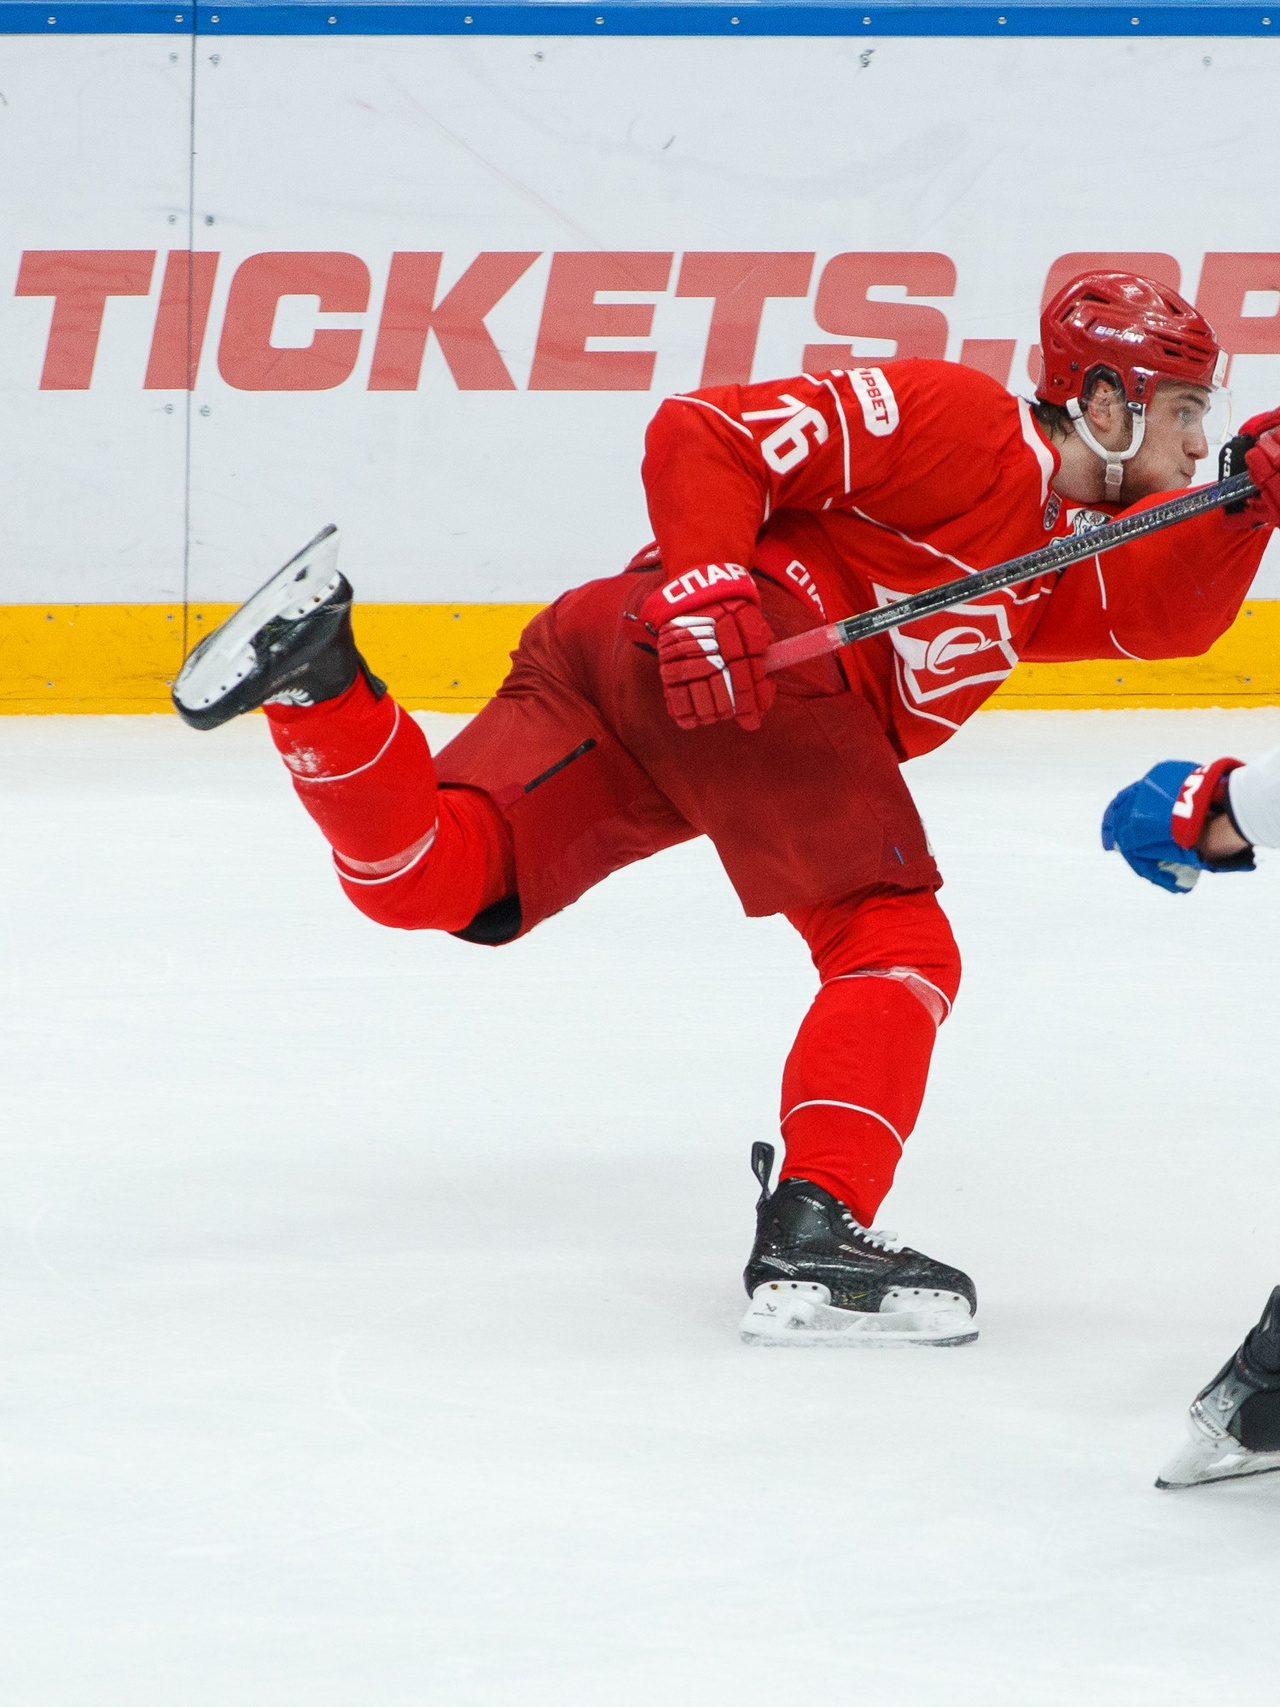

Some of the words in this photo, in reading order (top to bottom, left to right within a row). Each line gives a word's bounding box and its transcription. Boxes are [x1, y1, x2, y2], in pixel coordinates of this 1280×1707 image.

[741, 393, 829, 475] 76
[1223, 447, 1232, 481] CM
[661, 562, 757, 605] СПАР
